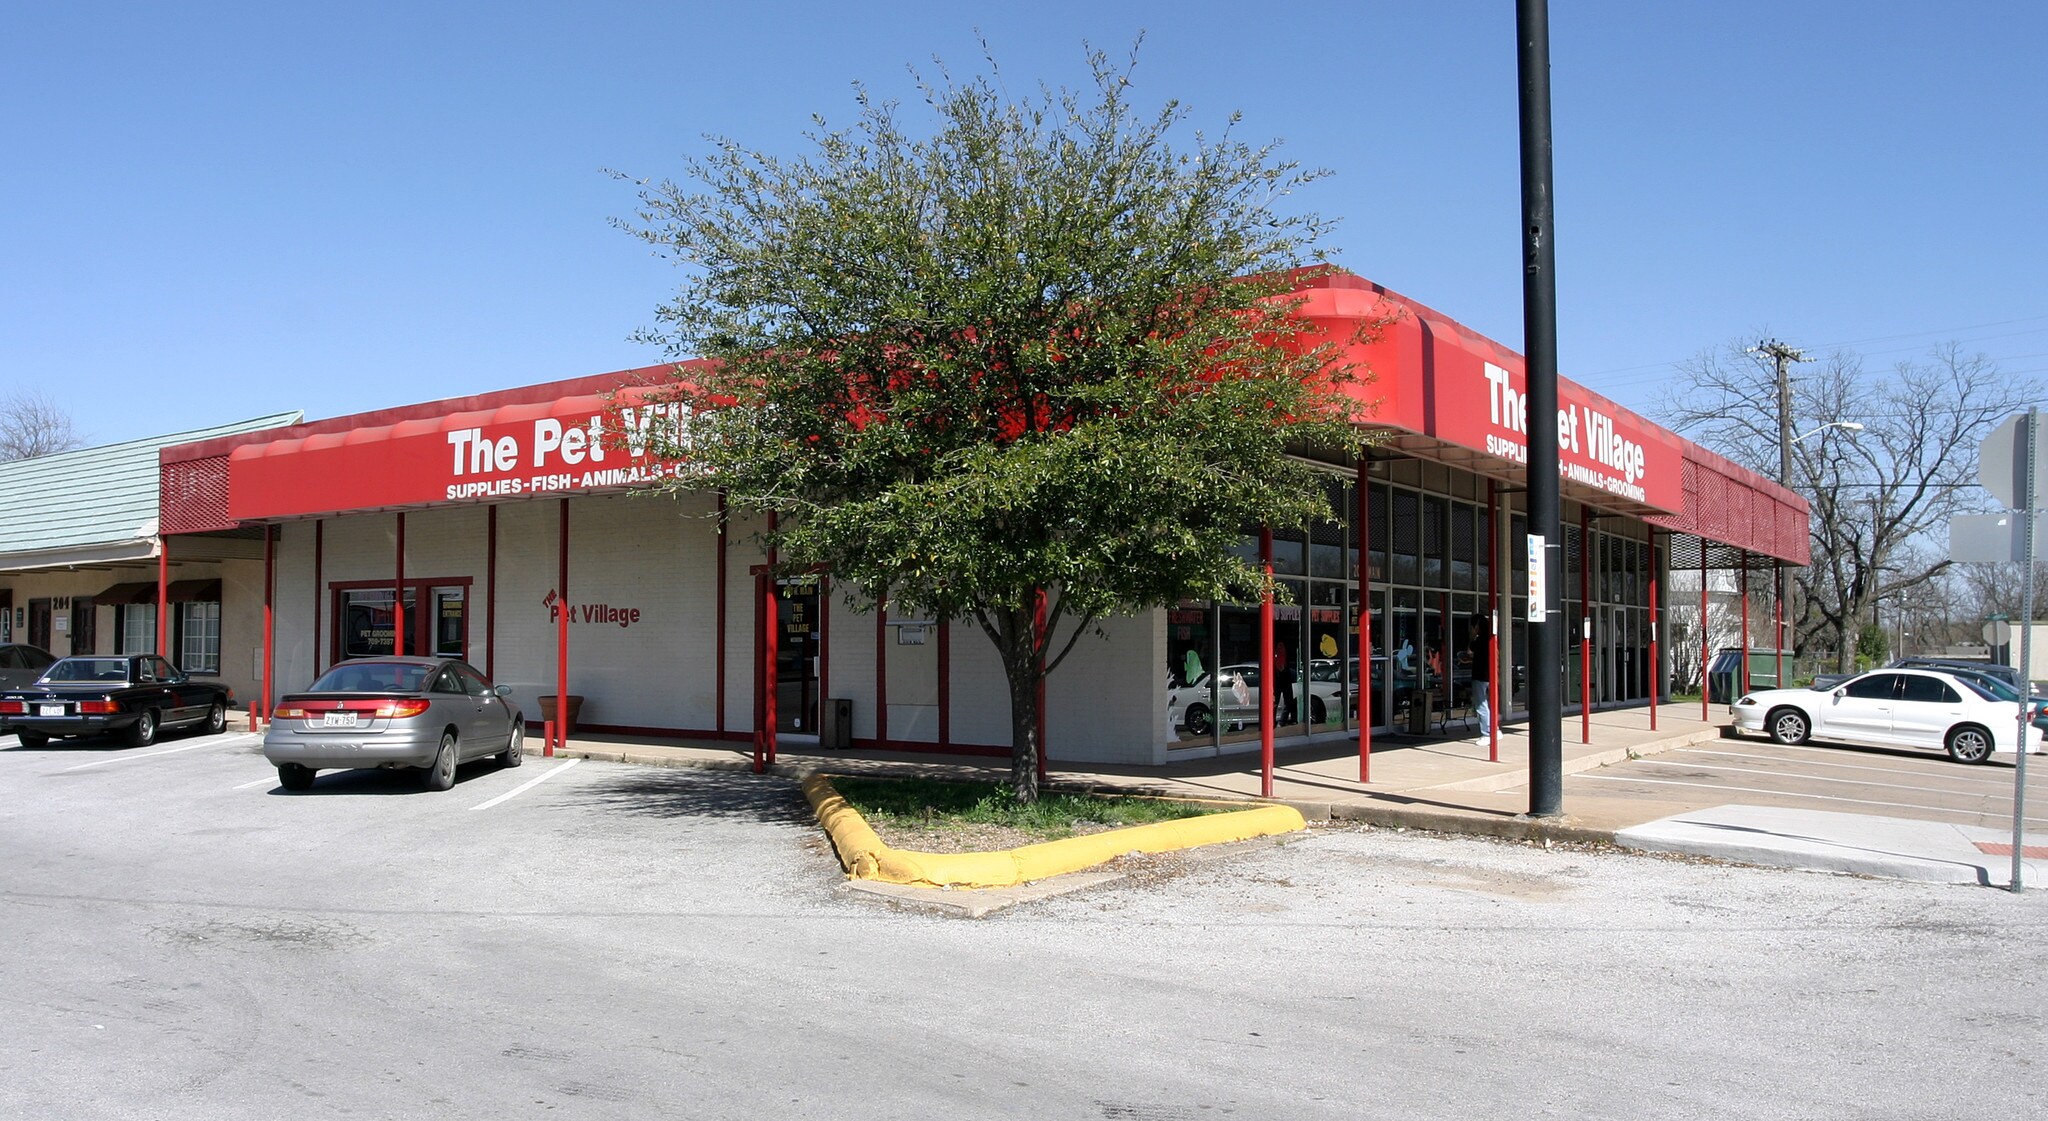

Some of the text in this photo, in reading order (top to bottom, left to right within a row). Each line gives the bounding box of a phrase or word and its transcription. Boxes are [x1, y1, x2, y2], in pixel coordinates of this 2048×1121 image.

[448, 428, 519, 476] The
[533, 415, 605, 468] Pet
[1557, 404, 1579, 454] et
[1583, 407, 1645, 484] Village
[53, 597, 70, 610] 204
[542, 588, 558, 609] THE
[793, 603, 804, 613] THE
[581, 604, 640, 628] Village
[787, 624, 810, 633] VILLAGE
